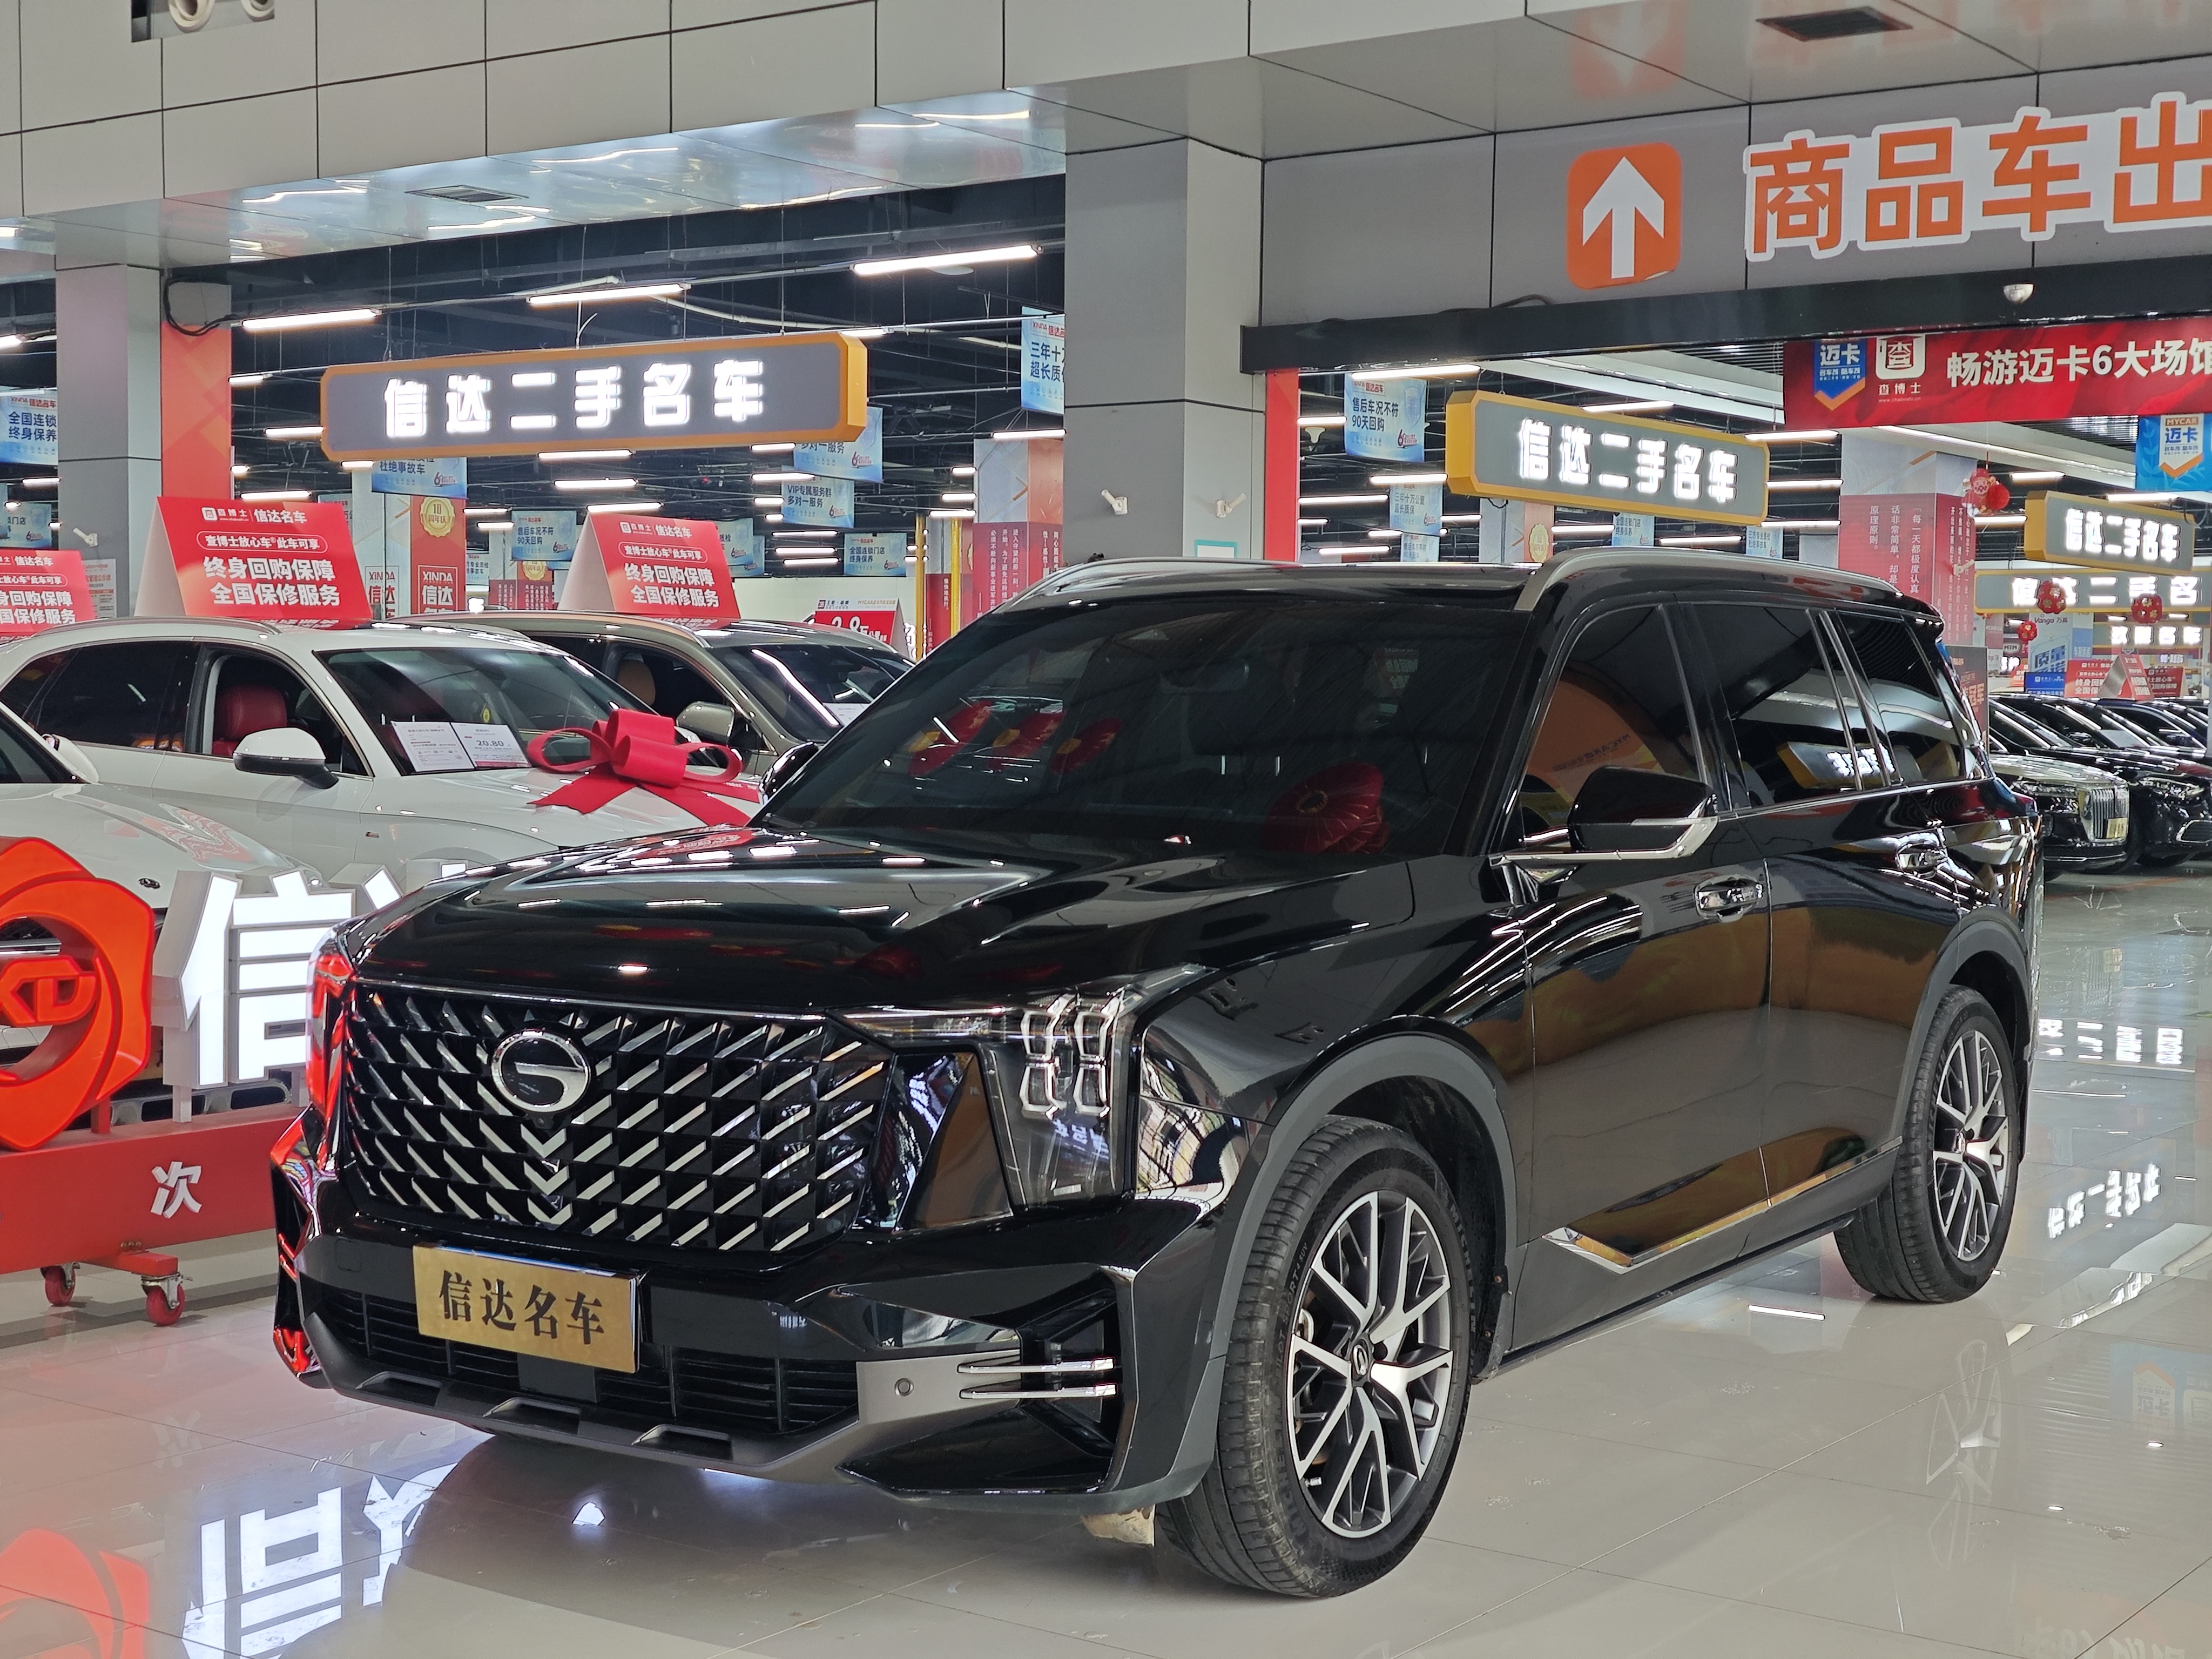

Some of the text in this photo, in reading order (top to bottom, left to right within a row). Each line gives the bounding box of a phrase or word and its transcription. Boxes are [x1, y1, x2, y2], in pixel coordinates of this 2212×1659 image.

[1820, 343, 1860, 366] 迈卡
[1879, 382, 1921, 396] 查博士
[384, 359, 765, 439] 信达二手名车
[1352, 396, 1399, 418] 售后车况不符
[1352, 415, 1385, 433] 90天回购
[2166, 417, 2197, 426] MYCAR
[8, 426, 57, 442] 终身保养
[2165, 427, 2198, 444] 迈卡
[379, 462, 426, 475] 杜绝事故车
[1518, 417, 1738, 504] 信达二手名车
[787, 485, 832, 498] VIP专属服务群
[787, 495, 824, 508] 多对一服务
[254, 509, 308, 523] 信达名车
[655, 524, 692, 538] 信达名车
[2065, 508, 2181, 562] 信达二手名车
[849, 546, 886, 555] 全国连锁门店
[15, 556, 54, 567] 信达名车
[203, 555, 336, 581] 终身回购保障
[422, 571, 454, 582] XINDA
[624, 562, 716, 587] 终身回购保障
[210, 582, 341, 606] 全国保修服务
[421, 584, 454, 605] 信达
[630, 584, 719, 609] 全国保修服务
[2034, 617, 2054, 625] Vango
[476, 739, 504, 747] 20.80
[150, 1161, 203, 1219] 次
[1283, 1270, 1299, 1325] SPORT
[1298, 1242, 1308, 1263] SUV
[439, 1270, 605, 1345] 信达名车
